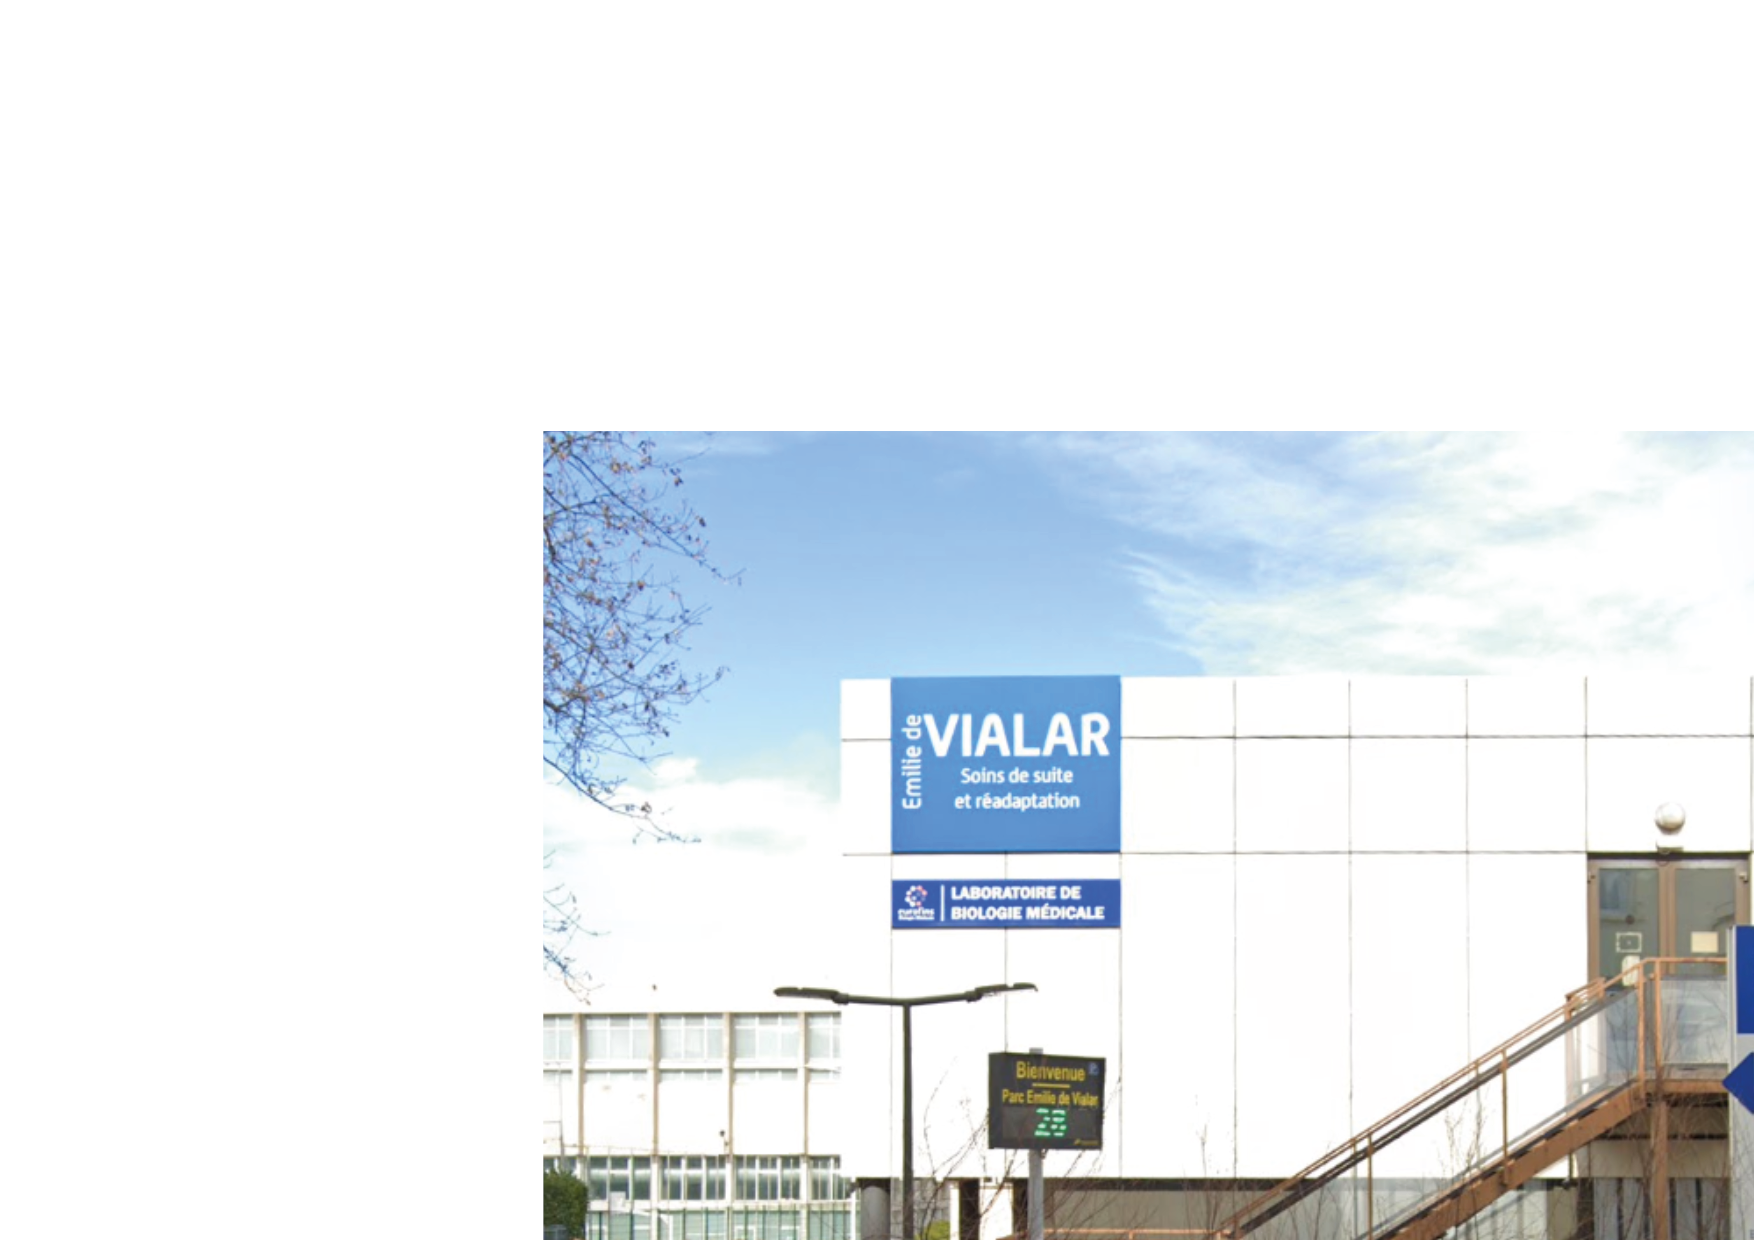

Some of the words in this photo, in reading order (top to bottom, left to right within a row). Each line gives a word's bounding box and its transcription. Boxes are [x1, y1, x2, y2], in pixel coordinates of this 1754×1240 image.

[901, 714, 922, 739] de
[923, 712, 1111, 757] VIALAR
[901, 746, 922, 809] Emilie
[961, 767, 1005, 783] Soins
[1008, 767, 1029, 783] de
[1033, 767, 1074, 783] suite
[954, 794, 971, 809] et
[975, 793, 1080, 811] réadaptation
[951, 886, 1057, 900] LABORATOIRE
[1060, 886, 1081, 900] DE
[951, 906, 1022, 920] BIOLOGIE
[1026, 903, 1105, 920] MÉDICALE
[1016, 1060, 1086, 1082] Bienvenue
[1002, 1089, 1025, 1104] Parc
[1027, 1089, 1056, 1104] Emilie
[1058, 1091, 1071, 1105] de
[1072, 1092, 1099, 1106] Vialar
